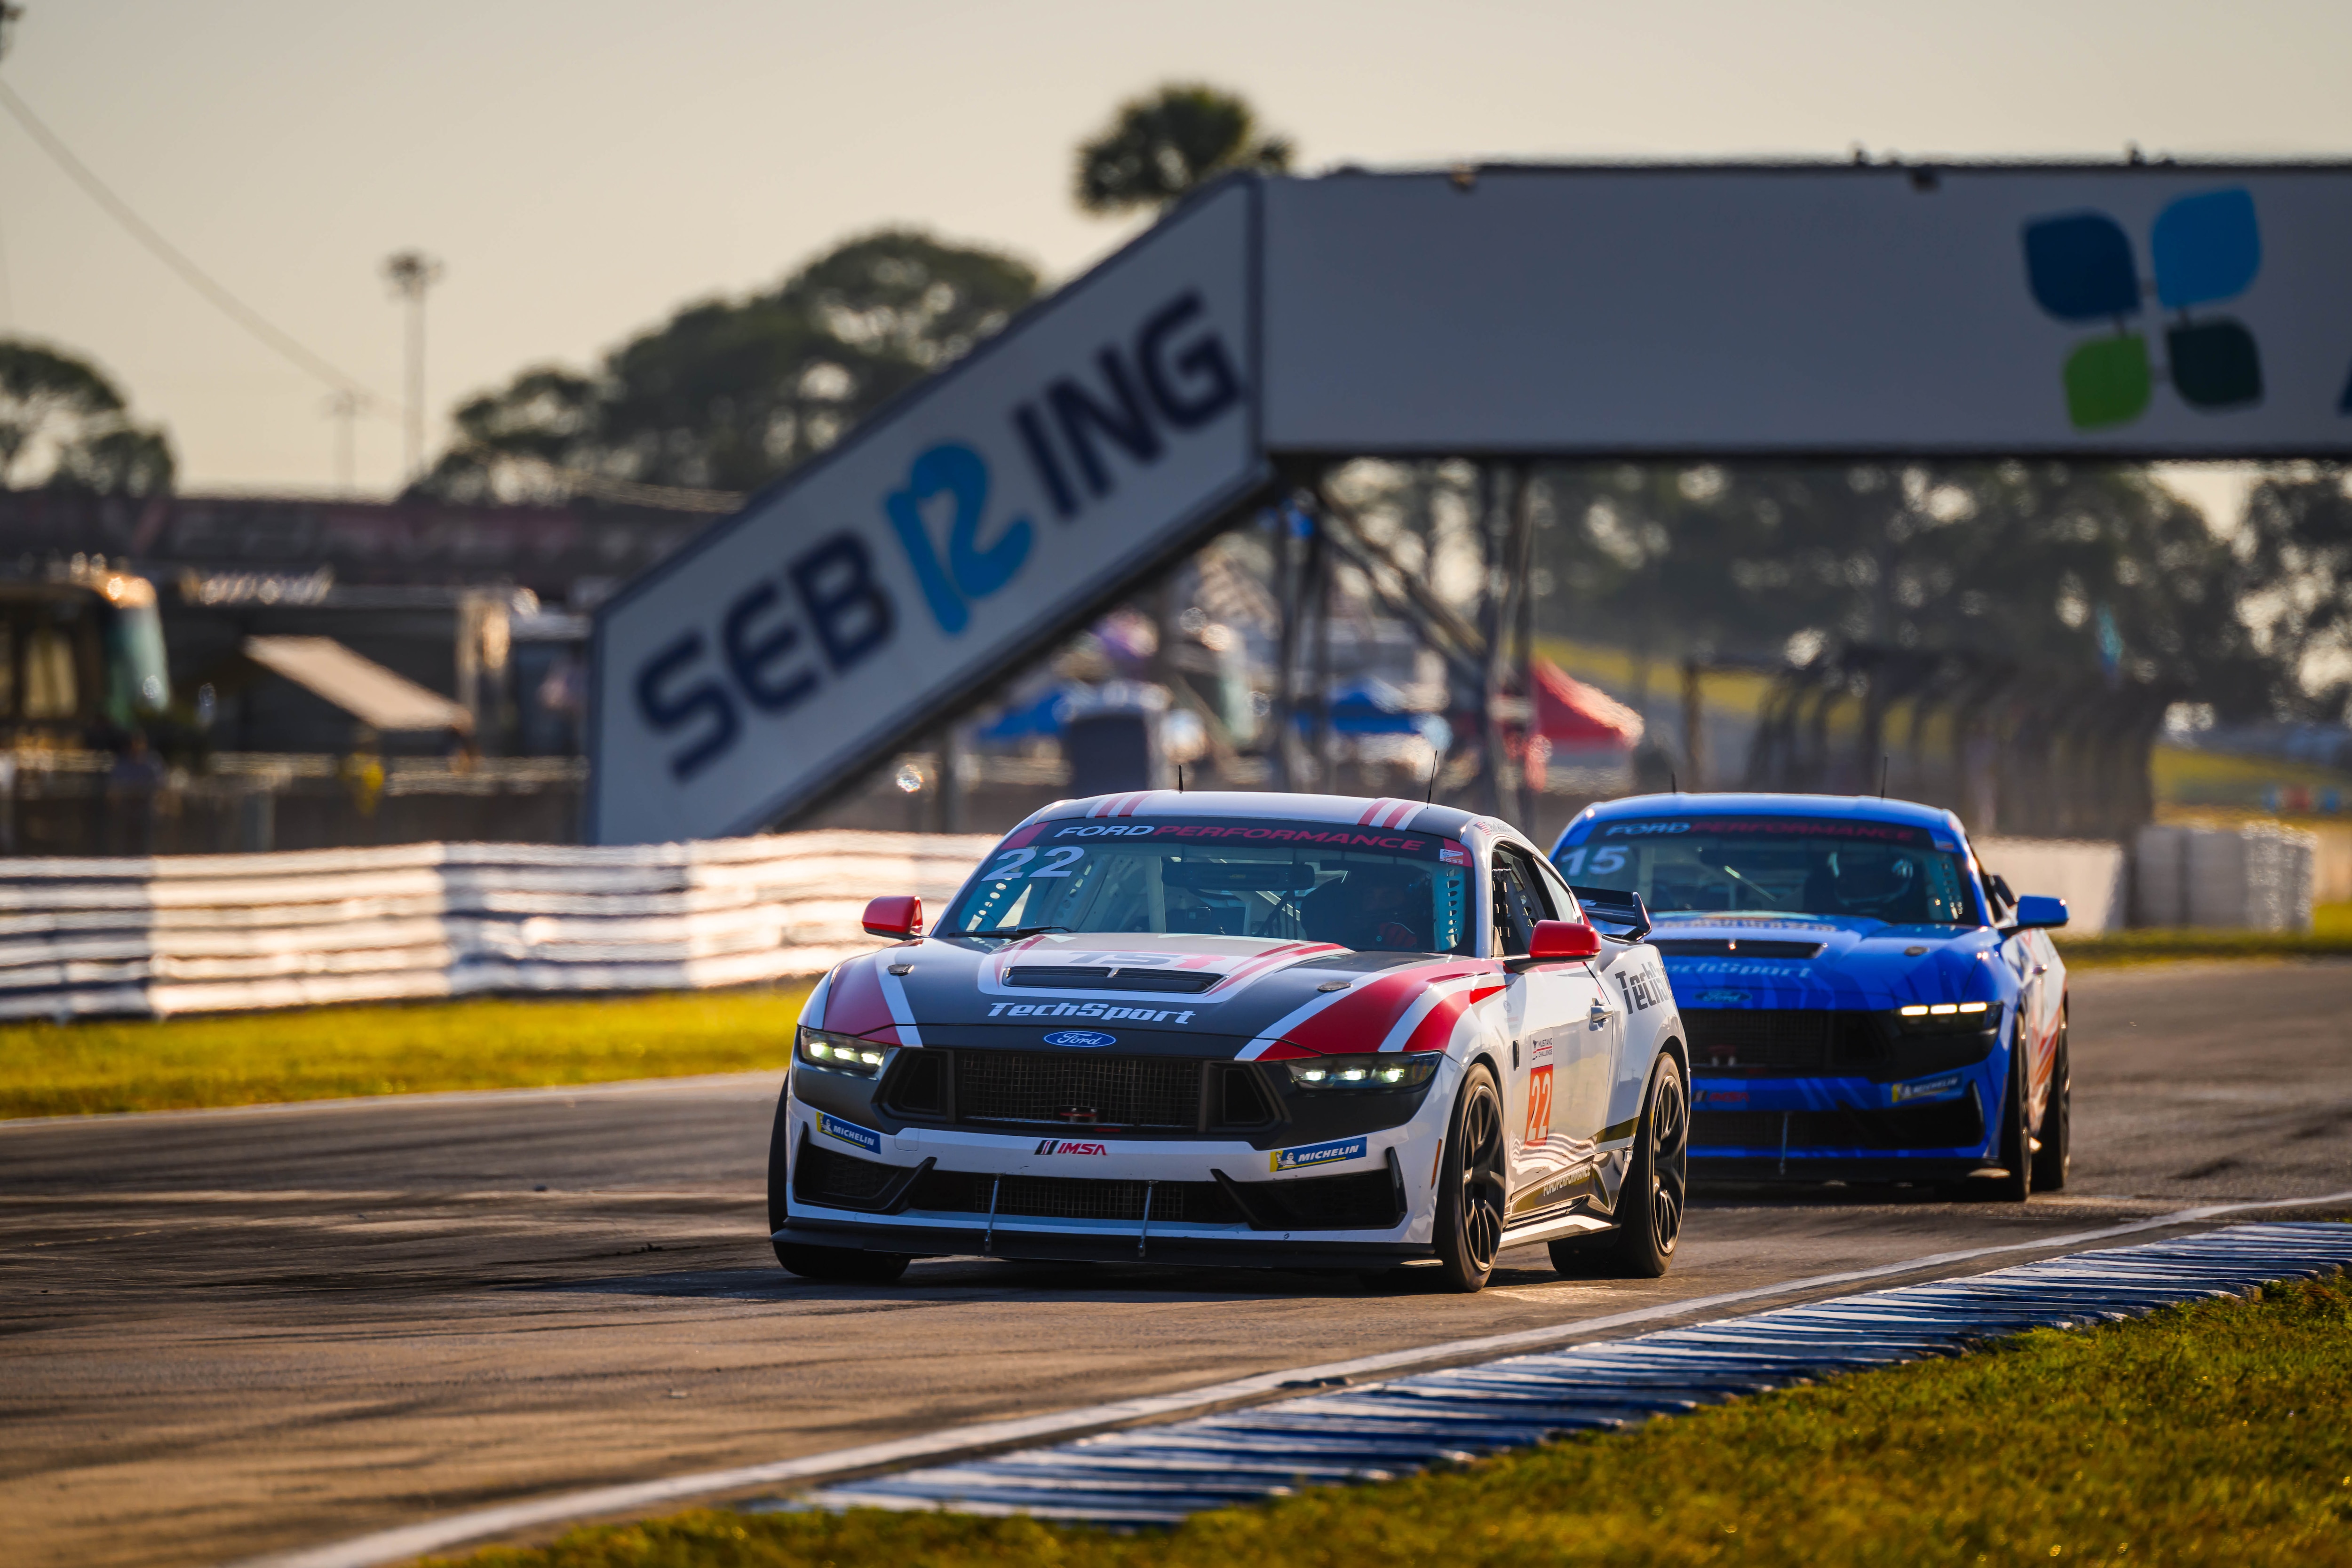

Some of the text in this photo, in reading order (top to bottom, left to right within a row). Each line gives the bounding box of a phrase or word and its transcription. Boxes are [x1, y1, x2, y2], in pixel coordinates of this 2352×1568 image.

[981, 846, 1084, 881] 22
[1561, 845, 1629, 875] 15
[987, 1003, 1196, 1024] TechSport
[1057, 1032, 1103, 1046] Ford
[1538, 1038, 1552, 1047] MUSTANG
[1538, 1049, 1552, 1058] CHALLENGE
[1527, 1072, 1551, 1141] 22
[833, 1125, 875, 1146] MICHELIN
[1057, 1142, 1108, 1156] IMSA
[1298, 1144, 1359, 1162] MICHELIN
